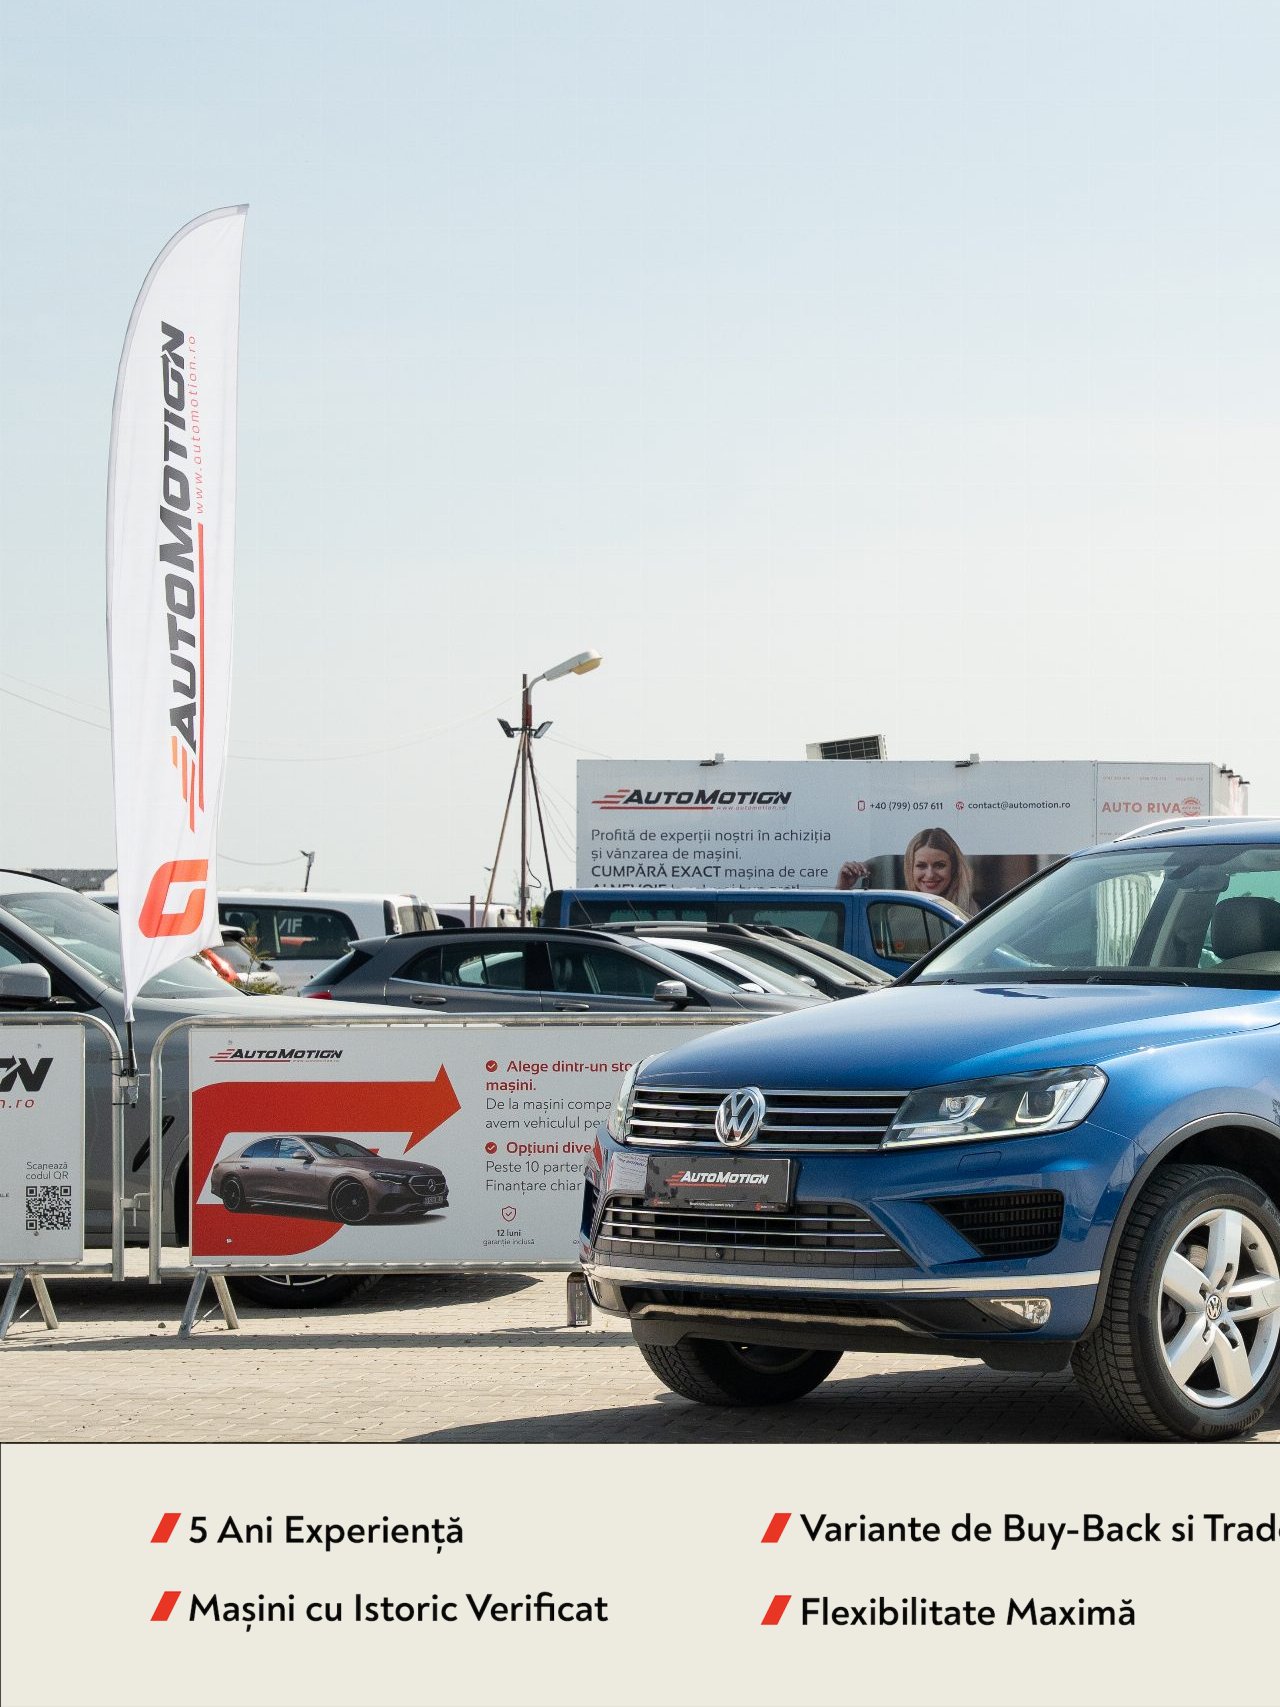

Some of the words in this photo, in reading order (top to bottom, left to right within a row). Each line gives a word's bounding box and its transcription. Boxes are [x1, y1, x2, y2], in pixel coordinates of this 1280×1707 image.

[187, 336, 204, 514] www.automotion.ro
[869, 801, 887, 810] +40
[888, 801, 911, 812] (799)
[912, 801, 929, 810] 057
[930, 802, 943, 810] 611
[967, 800, 1071, 811] contact@automotion.ro
[1101, 802, 1143, 813] AUTO
[1147, 803, 1182, 814] RIVA
[591, 828, 636, 841] Profită
[640, 829, 657, 841] de
[660, 829, 711, 844] experții
[715, 829, 754, 844] noștri
[757, 829, 770, 841] în
[774, 829, 831, 844] achiziția
[591, 847, 602, 862] și
[672, 847, 689, 860] de
[693, 847, 742, 863] mașini.
[591, 863, 668, 878] CUMPĂRĂ
[671, 865, 722, 878] EXACT
[724, 866, 775, 881] mașina
[778, 865, 796, 878] de
[799, 868, 829, 878] care
[506, 1060, 549, 1075] Alege
[552, 1060, 608, 1073] dintr-un
[486, 1078, 537, 1094] mașini.
[486, 1097, 505, 1110] De
[508, 1097, 519, 1110] la
[523, 1098, 564, 1114] mașini
[485, 1120, 520, 1129] avem
[523, 1115, 580, 1129] vehiculul
[506, 1141, 559, 1157] Opțiuni
[26, 1161, 68, 1171] Scanează
[486, 1160, 522, 1173] Peste
[525, 1160, 540, 1173] 10
[26, 1170, 51, 1180] codul
[53, 1170, 69, 1180] QR
[486, 1179, 547, 1196] Finanțare
[550, 1178, 583, 1191] chiar
[496, 1229, 505, 1237] 12
[506, 1228, 522, 1237] luni
